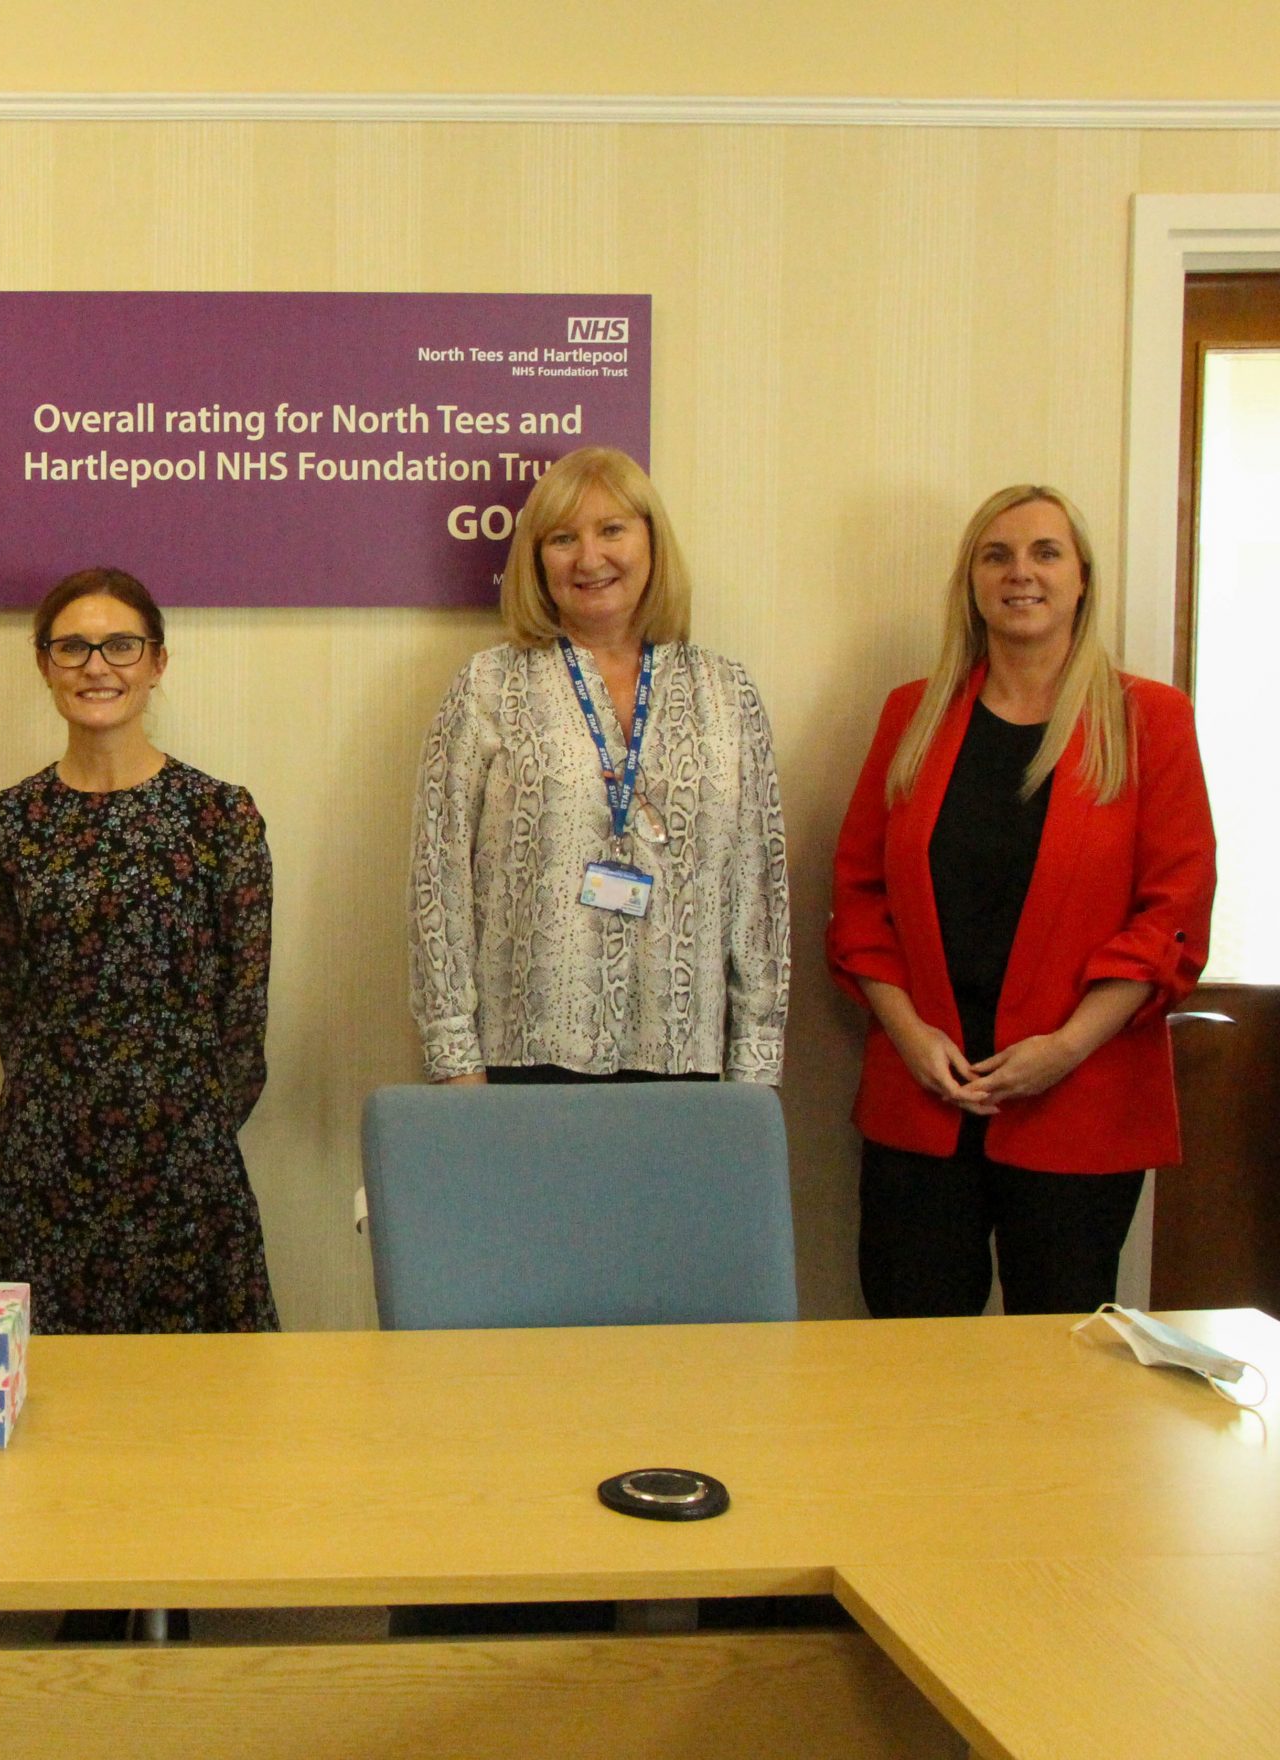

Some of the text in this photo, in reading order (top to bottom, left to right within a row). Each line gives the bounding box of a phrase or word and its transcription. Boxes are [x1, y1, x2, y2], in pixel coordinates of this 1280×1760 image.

[569, 319, 626, 341] NHS
[417, 347, 628, 366] North Tees and Hartlepool
[511, 366, 629, 377] NHS Foundation Trust
[33, 402, 582, 441] Overall rating for North Tees and
[24, 450, 554, 488] Hartlepool NHS Foundation Tru
[447, 504, 525, 541] GO
[564, 647, 577, 668] STAFF
[575, 679, 589, 701] STAFF
[586, 713, 600, 735] STAFF
[599, 747, 612, 770] STAFF
[620, 783, 632, 810] STAFF
[627, 749, 638, 770] STAFF
[638, 684, 648, 706] STAFF
